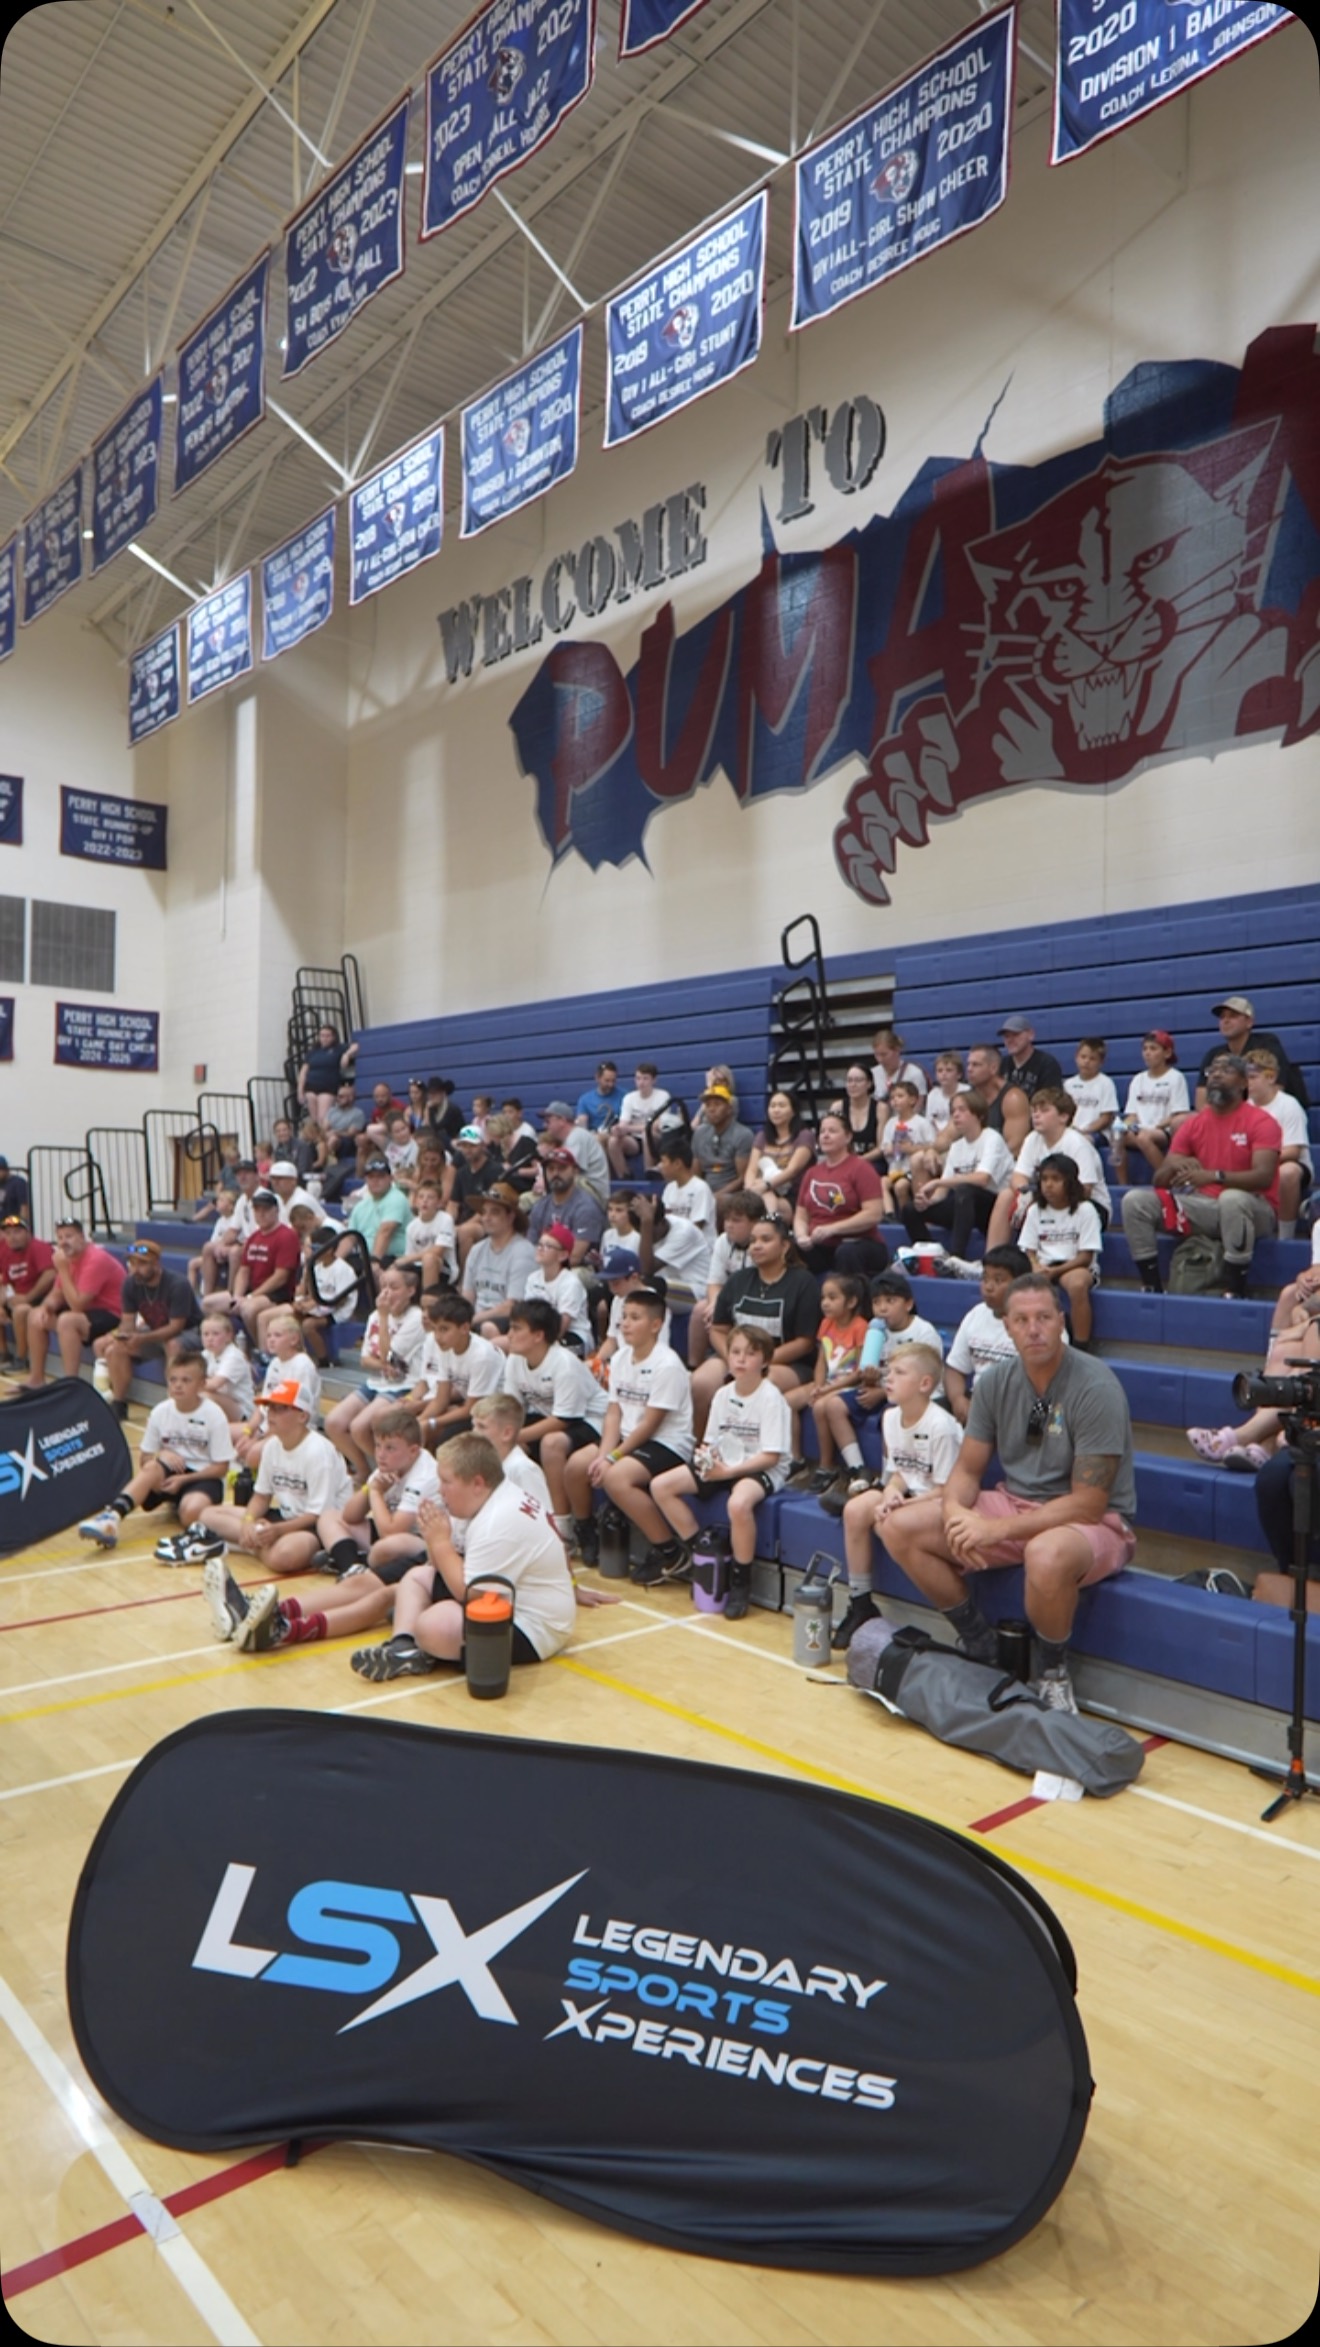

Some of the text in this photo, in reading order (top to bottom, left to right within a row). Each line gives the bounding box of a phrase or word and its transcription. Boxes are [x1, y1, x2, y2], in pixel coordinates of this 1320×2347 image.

[1068, 1, 1137, 66] 2020
[1100, 81, 1145, 120] COACH
[1208, 1, 1277, 57] JOHNSON
[1080, 35, 1160, 103] DIVISION
[814, 47, 992, 185] PERRY HIGH SCHOOL
[823, 83, 977, 199] STATE CHAMPIONS
[937, 103, 992, 162] 2020
[809, 199, 852, 248] 2019
[896, 187, 938, 226] SHOW
[940, 155, 990, 200] CHEER
[619, 220, 749, 325] PERRY HIGH SCHOOL
[627, 247, 740, 339] STATE CHAMPIONS
[711, 269, 754, 316] 2020
[830, 265, 865, 295] COACH
[700, 320, 740, 357] STUNT
[437, 395, 886, 684] WELCOME TO
[549, 455, 995, 845] PUMA
[67, 794, 158, 823] PERRY HIGH SCHOOL
[72, 812, 99, 828] STATE
[63, 1009, 93, 1025] PERRY
[119, 1015, 154, 1030] SCHOOL
[38, 1420, 89, 1449] LEGENDARY
[44, 1437, 83, 1462] SPORTS
[50, 1442, 106, 1478] XPERIENCES
[191, 1862, 888, 2035] LSX LEGENDARY
[562, 1957, 793, 2035] SPORTS
[542, 1998, 898, 2110] XPERIENCES
